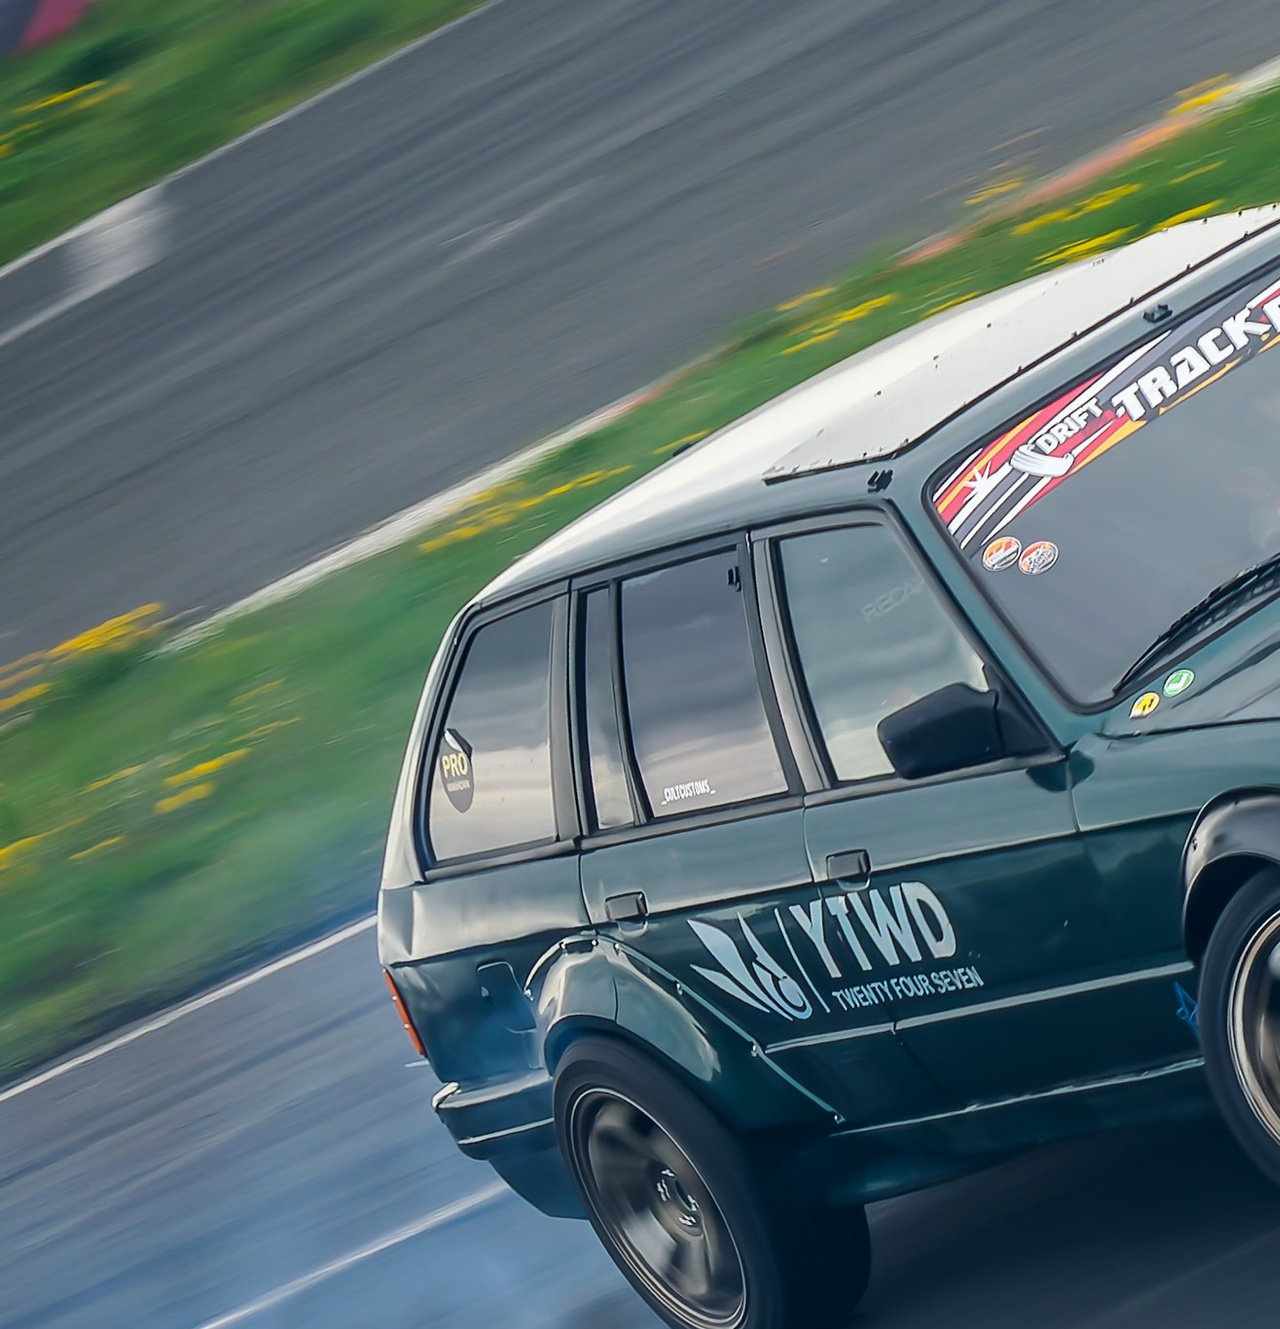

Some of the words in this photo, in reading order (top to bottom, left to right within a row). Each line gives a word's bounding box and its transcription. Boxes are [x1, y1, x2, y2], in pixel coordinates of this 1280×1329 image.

[1036, 397, 1103, 454] DRIFT
[1110, 307, 1271, 421] TRACK
[441, 752, 469, 779] PRO
[788, 881, 957, 979] YTWD
[832, 979, 894, 1012] TWENTY
[890, 973, 935, 999] FOUR
[930, 965, 985, 994] SEVEN
